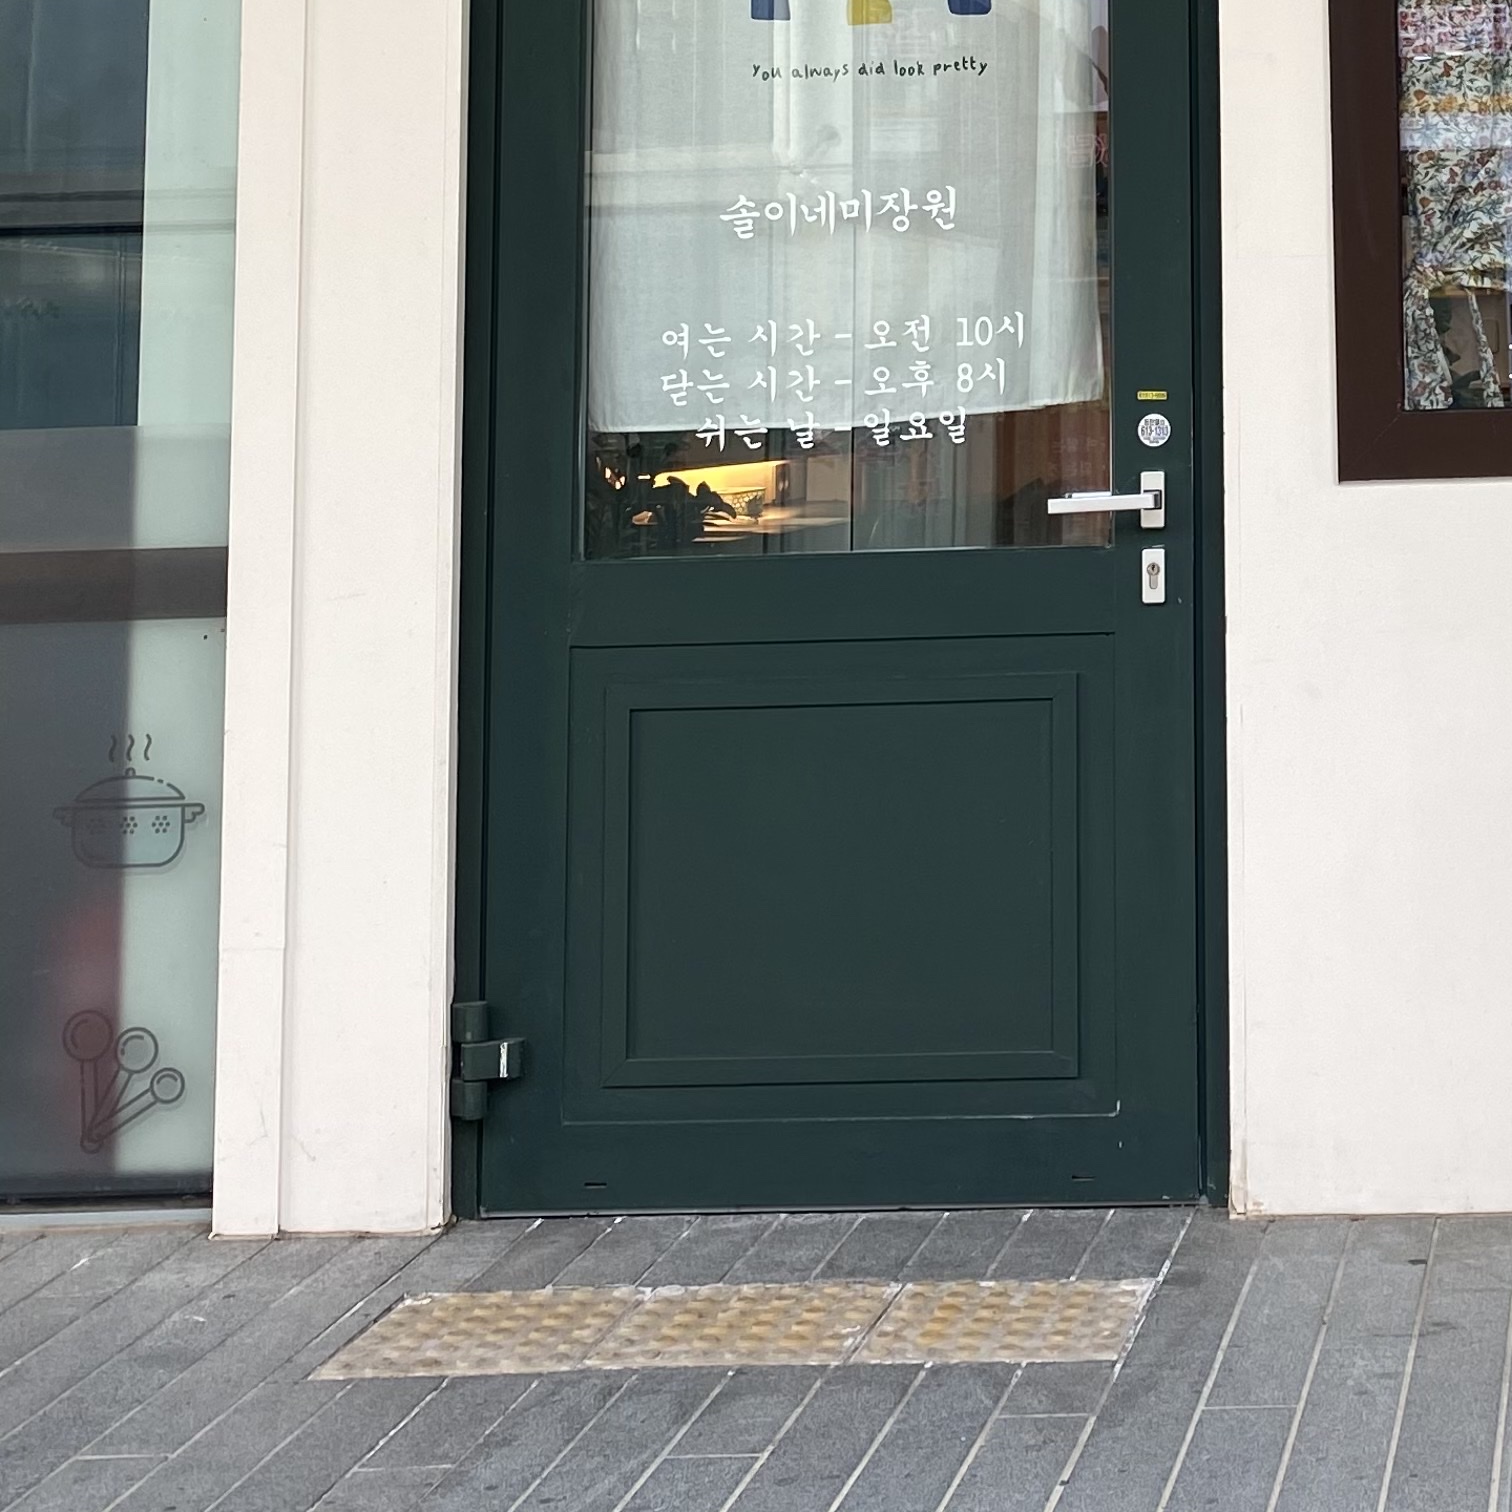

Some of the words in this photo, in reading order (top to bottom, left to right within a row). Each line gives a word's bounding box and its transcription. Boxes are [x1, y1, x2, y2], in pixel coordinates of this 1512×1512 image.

[791, 63, 849, 83] always
[858, 61, 885, 76] did
[894, 59, 925, 76] look
[933, 56, 988, 76] pretty
[719, 185, 956, 239] 솔이네미장원
[662, 322, 732, 360] 여는
[748, 318, 821, 357] 시간
[864, 314, 930, 352] 오전
[956, 311, 1024, 348] 10시
[660, 369, 731, 407] 닫는
[747, 364, 821, 403] 시간
[864, 360, 934, 398] 오후
[956, 357, 1005, 395] 8시
[695, 414, 769, 453] 쉬는
[786, 411, 821, 450] 날
[864, 406, 966, 447] 일요일
